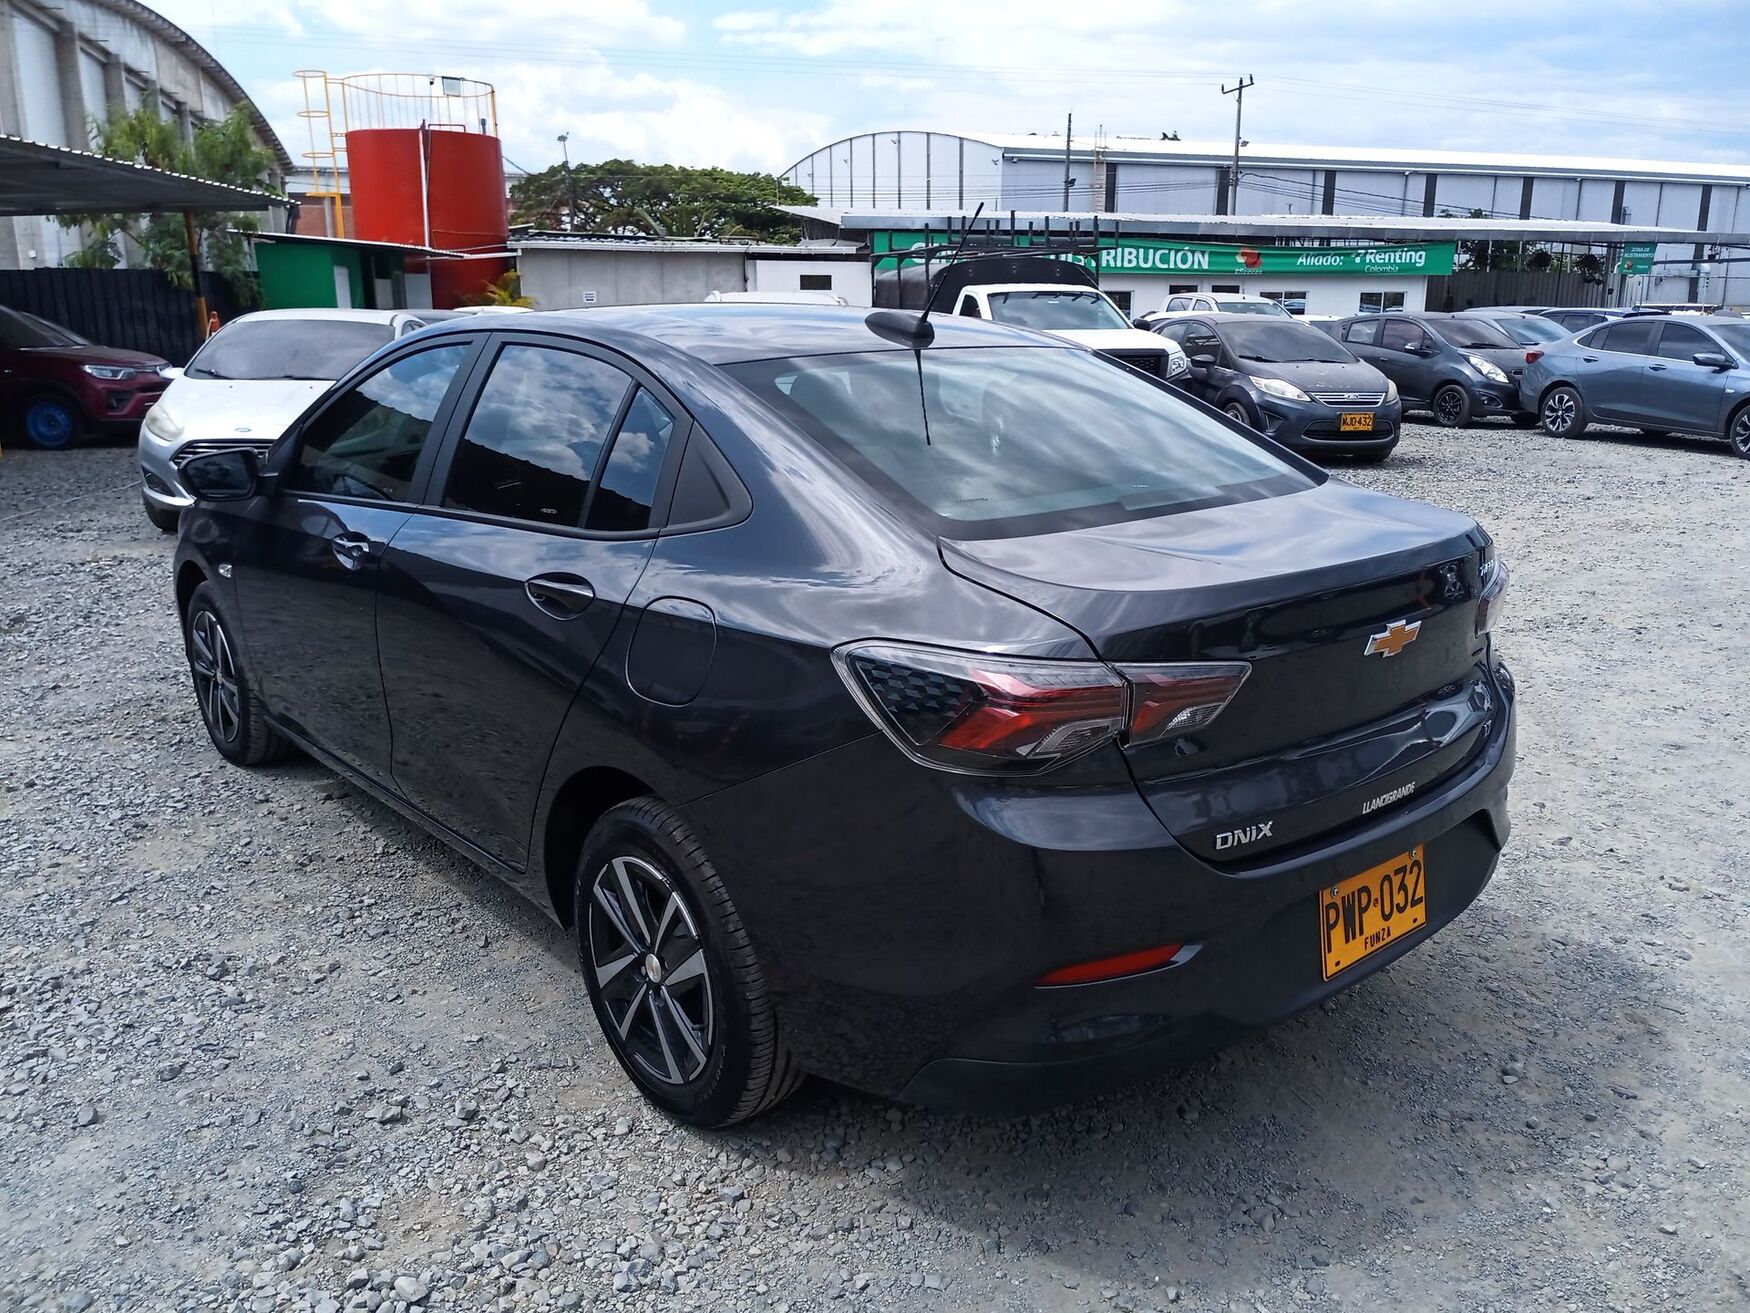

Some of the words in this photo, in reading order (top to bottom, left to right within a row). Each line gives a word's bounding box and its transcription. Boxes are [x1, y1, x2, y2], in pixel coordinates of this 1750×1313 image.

[1296, 251, 1344, 266] Aliado:
[1365, 247, 1426, 267] Renting
[1364, 265, 1399, 273] Colombia
[1364, 925, 1392, 951] FUNZA
